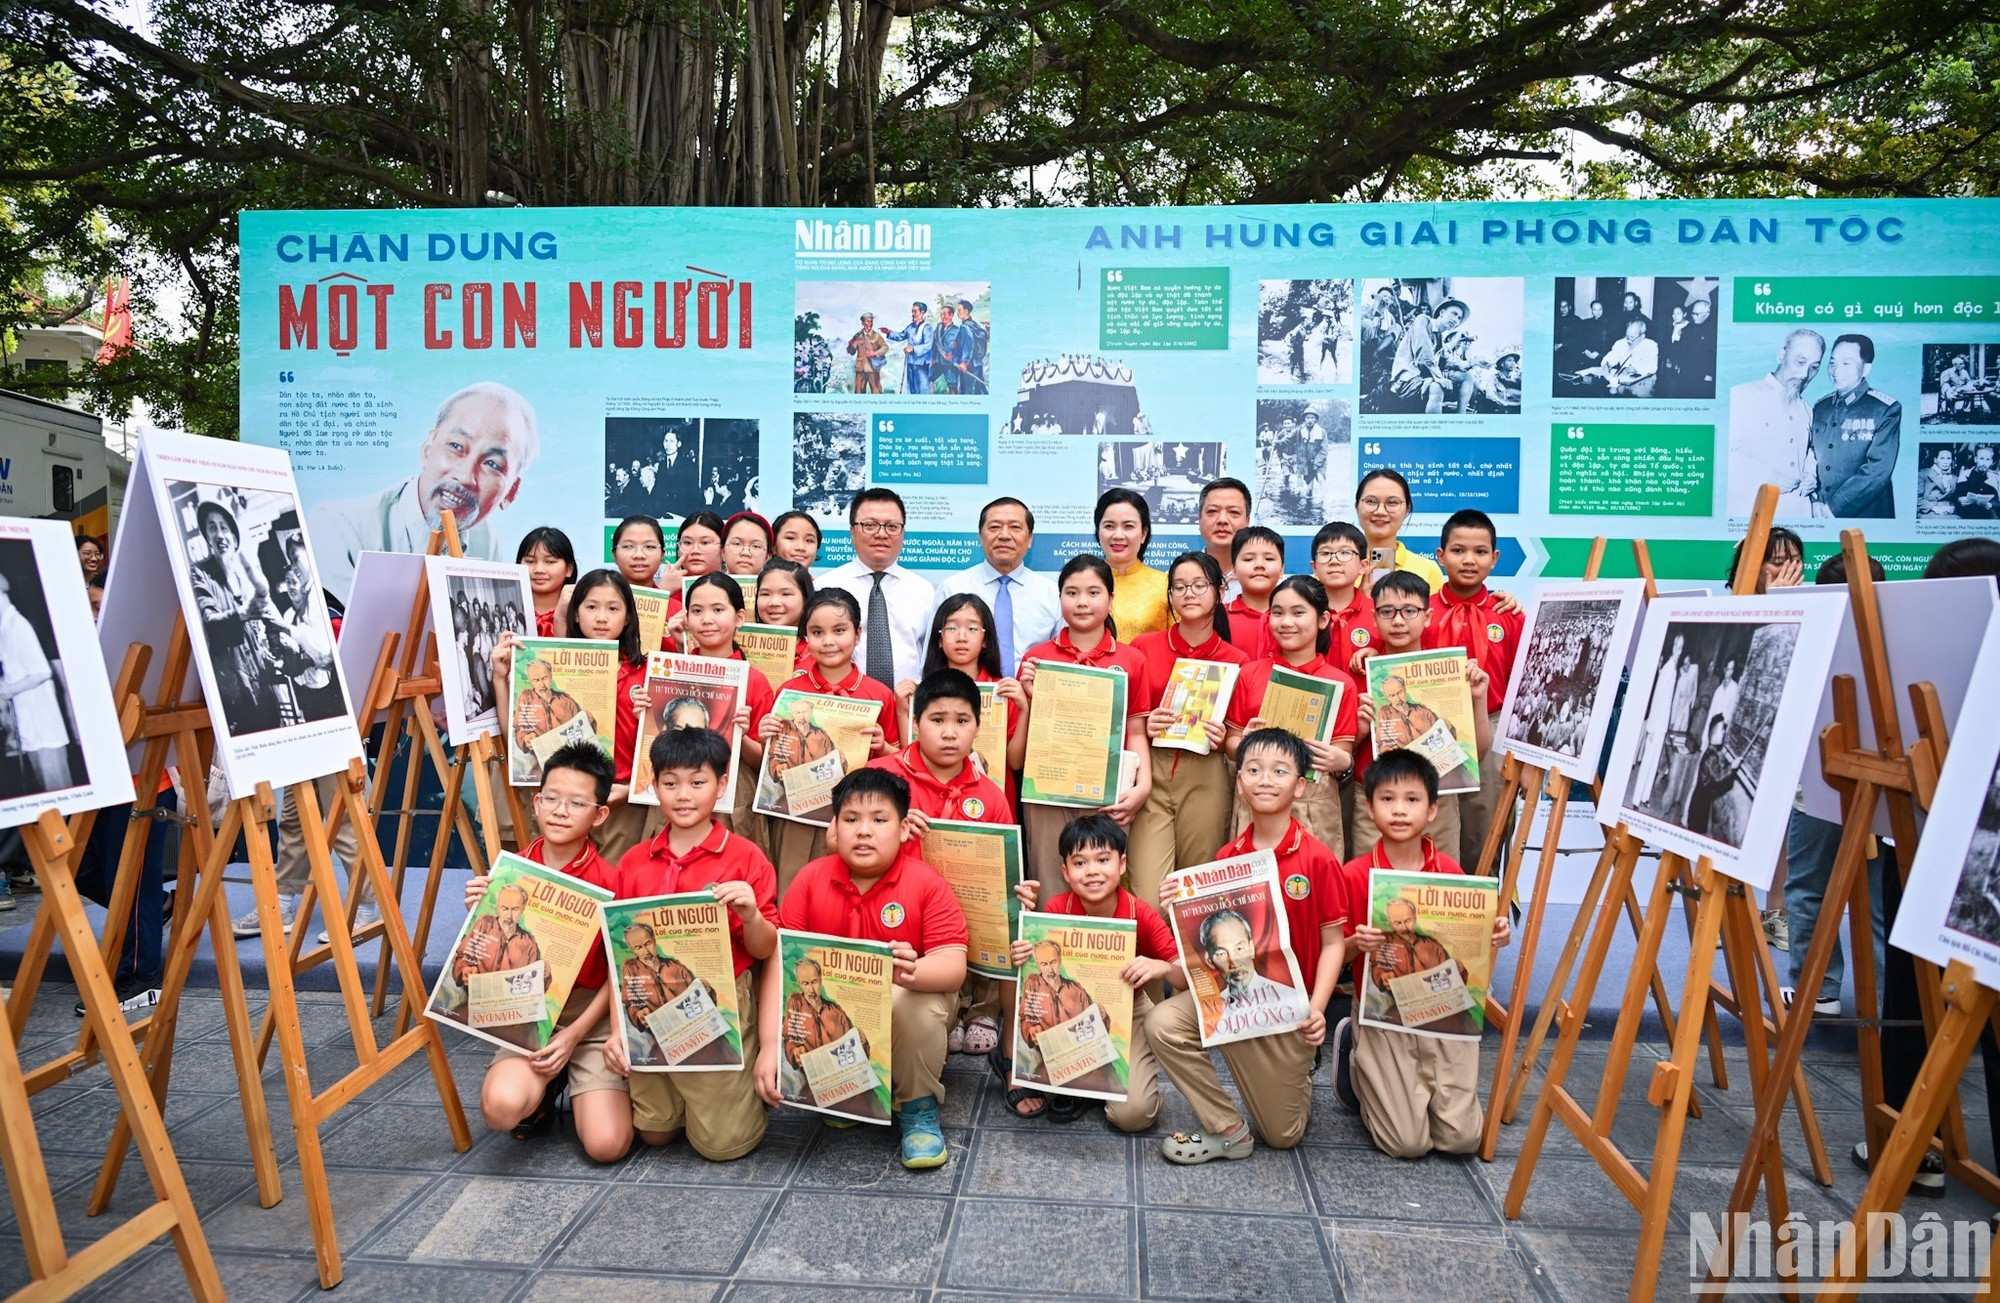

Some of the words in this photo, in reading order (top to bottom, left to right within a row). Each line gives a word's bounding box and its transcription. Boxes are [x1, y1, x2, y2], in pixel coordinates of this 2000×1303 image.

[795, 219, 870, 251] Nhân
[875, 219, 932, 251] Dân
[1084, 224, 1181, 249] ANH
[428, 231, 557, 262] DUNG
[278, 272, 395, 357] MỘT
[424, 281, 536, 350] CON
[569, 265, 752, 350] NGƯỜI
[1755, 301, 1805, 317] Không
[1814, 301, 1834, 315] có
[1844, 302, 1863, 317] gì
[1873, 301, 1903, 317] quý
[1914, 301, 1943, 315] hơn
[1953, 301, 1983, 317] độc
[296, 392, 308, 400] tộc
[312, 392, 323, 400] ta,
[365, 392, 376, 400] ta,
[296, 401, 313, 409] sông
[316, 400, 329, 408] đất
[320, 410, 337, 419] tịch
[381, 410, 397, 419] hùng
[296, 420, 308, 428] tộc
[324, 420, 340, 428] đại,
[381, 429, 393, 438] tộc
[280, 439, 291, 447] ta,
[373, 439, 389, 448] sông
[825, 545, 853, 553] NGUYỄN
[922, 538, 945, 547] NGOÀI,
[1167, 542, 1190, 550] CÔNG,
[925, 546, 948, 555] CHUẨN
[949, 548, 957, 556] BỊ
[958, 548, 972, 556] CHO
[920, 554, 941, 563] GIÀNH
[942, 555, 956, 564] ĐỘC
[1148, 558, 1170, 567] CỘNG
[1895, 554, 1911, 563] CÒN
[1902, 563, 1920, 572] NGÀY
[741, 633, 757, 649] LỜI
[759, 633, 788, 652] NGƯỜI
[553, 649, 572, 666] LỜI
[574, 650, 610, 668] NGƯỜI
[674, 659, 703, 674] Nhân
[703, 662, 726, 677] Dân
[1404, 662, 1422, 679] LỜI
[1425, 657, 1460, 677] NGƯỜI
[837, 702, 871, 714] NGƯỜI
[1194, 869, 1228, 887] Nhân
[1227, 862, 1252, 880] Dân
[532, 881, 556, 903] LỜI
[555, 890, 598, 919] NGƯỜI
[1418, 886, 1439, 907] LỜI
[1443, 889, 1486, 910] NGƯỜI
[651, 907, 674, 928] LỜI
[677, 904, 719, 926] NGƯỜI
[1063, 929, 1083, 948] LỜI
[1087, 931, 1126, 952] NGƯỜI
[823, 948, 842, 969] LỜI
[846, 953, 883, 976] NGƯỜI
